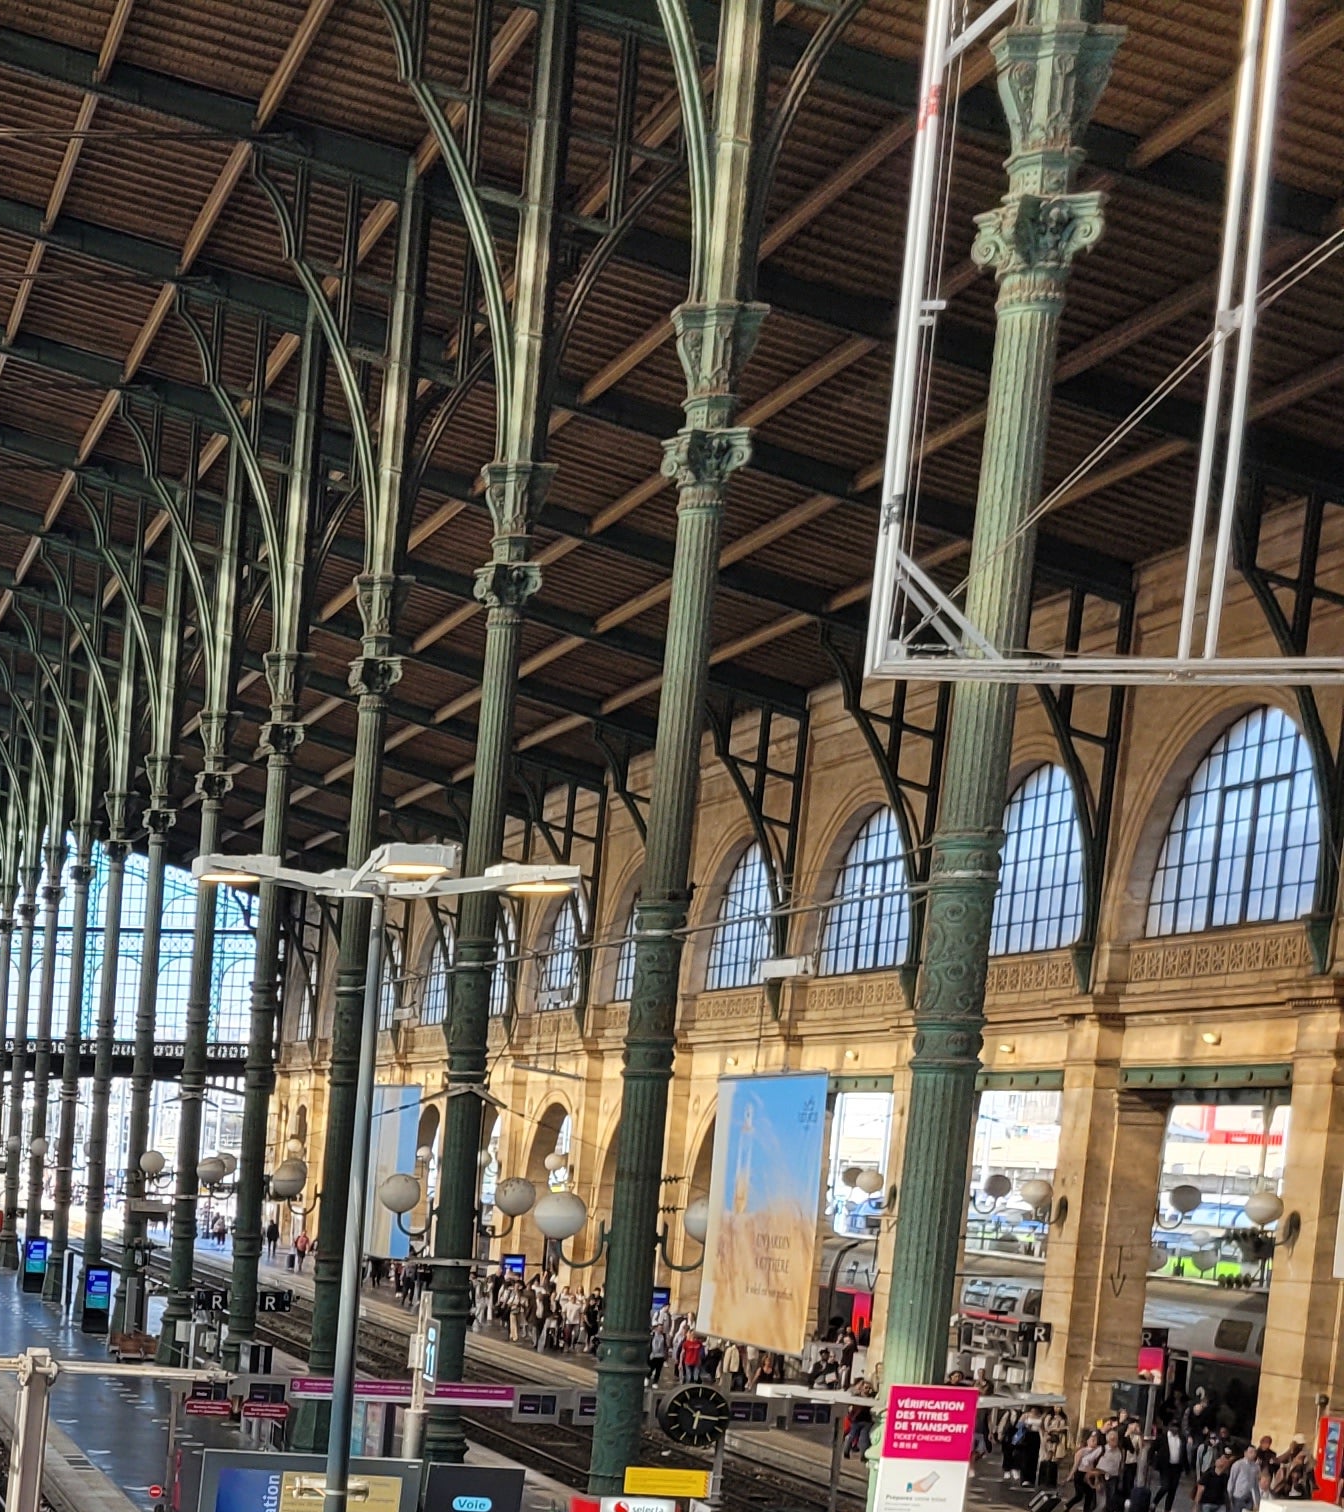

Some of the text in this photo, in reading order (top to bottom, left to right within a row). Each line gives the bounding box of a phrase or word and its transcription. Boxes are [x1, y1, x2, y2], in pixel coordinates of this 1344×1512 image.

[212, 1295, 223, 1310] R
[265, 1295, 276, 1311] R
[1033, 1326, 1045, 1341] R
[898, 1398, 965, 1411] VÉRIFICATION
[896, 1410, 949, 1421] DES TITRES
[894, 1422, 969, 1433] DE TRANSPORT
[457, 1499, 486, 1510] Voie
